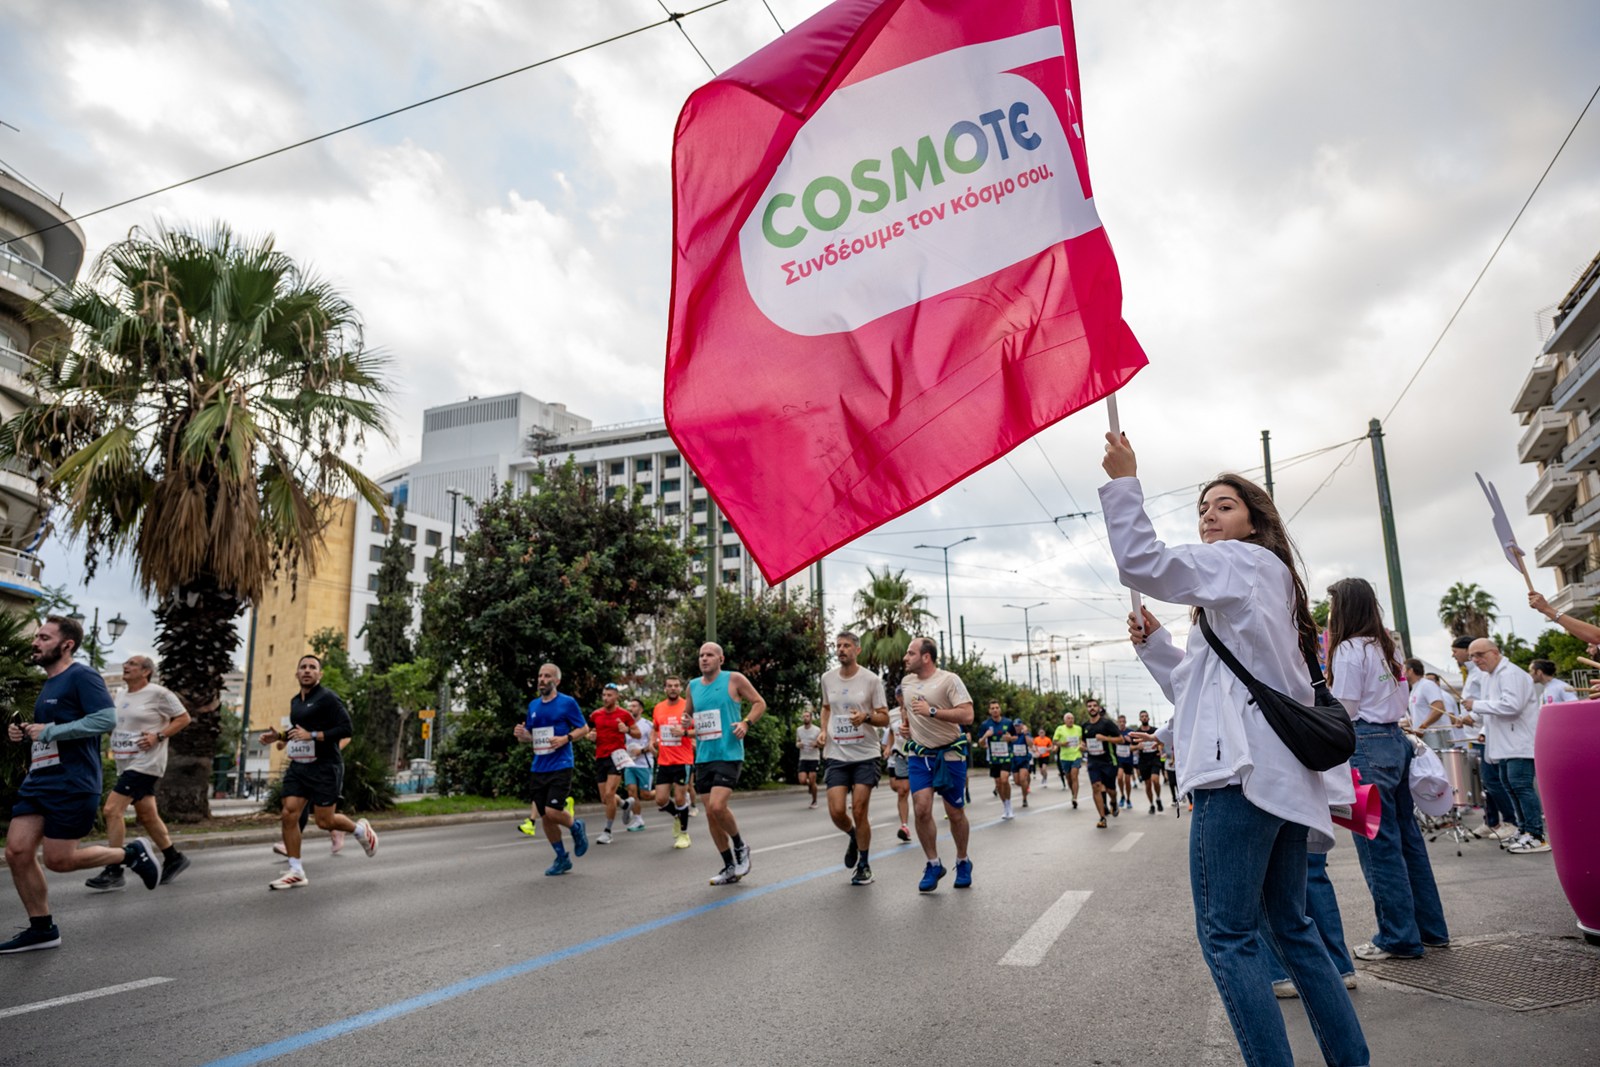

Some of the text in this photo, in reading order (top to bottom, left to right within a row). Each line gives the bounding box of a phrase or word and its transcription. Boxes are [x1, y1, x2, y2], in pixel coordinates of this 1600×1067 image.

[761, 102, 1042, 249] COSMOTE
[780, 163, 1054, 286] Συνδέουμε τον κόσμο σου.
[836, 725, 859, 733] 34374
